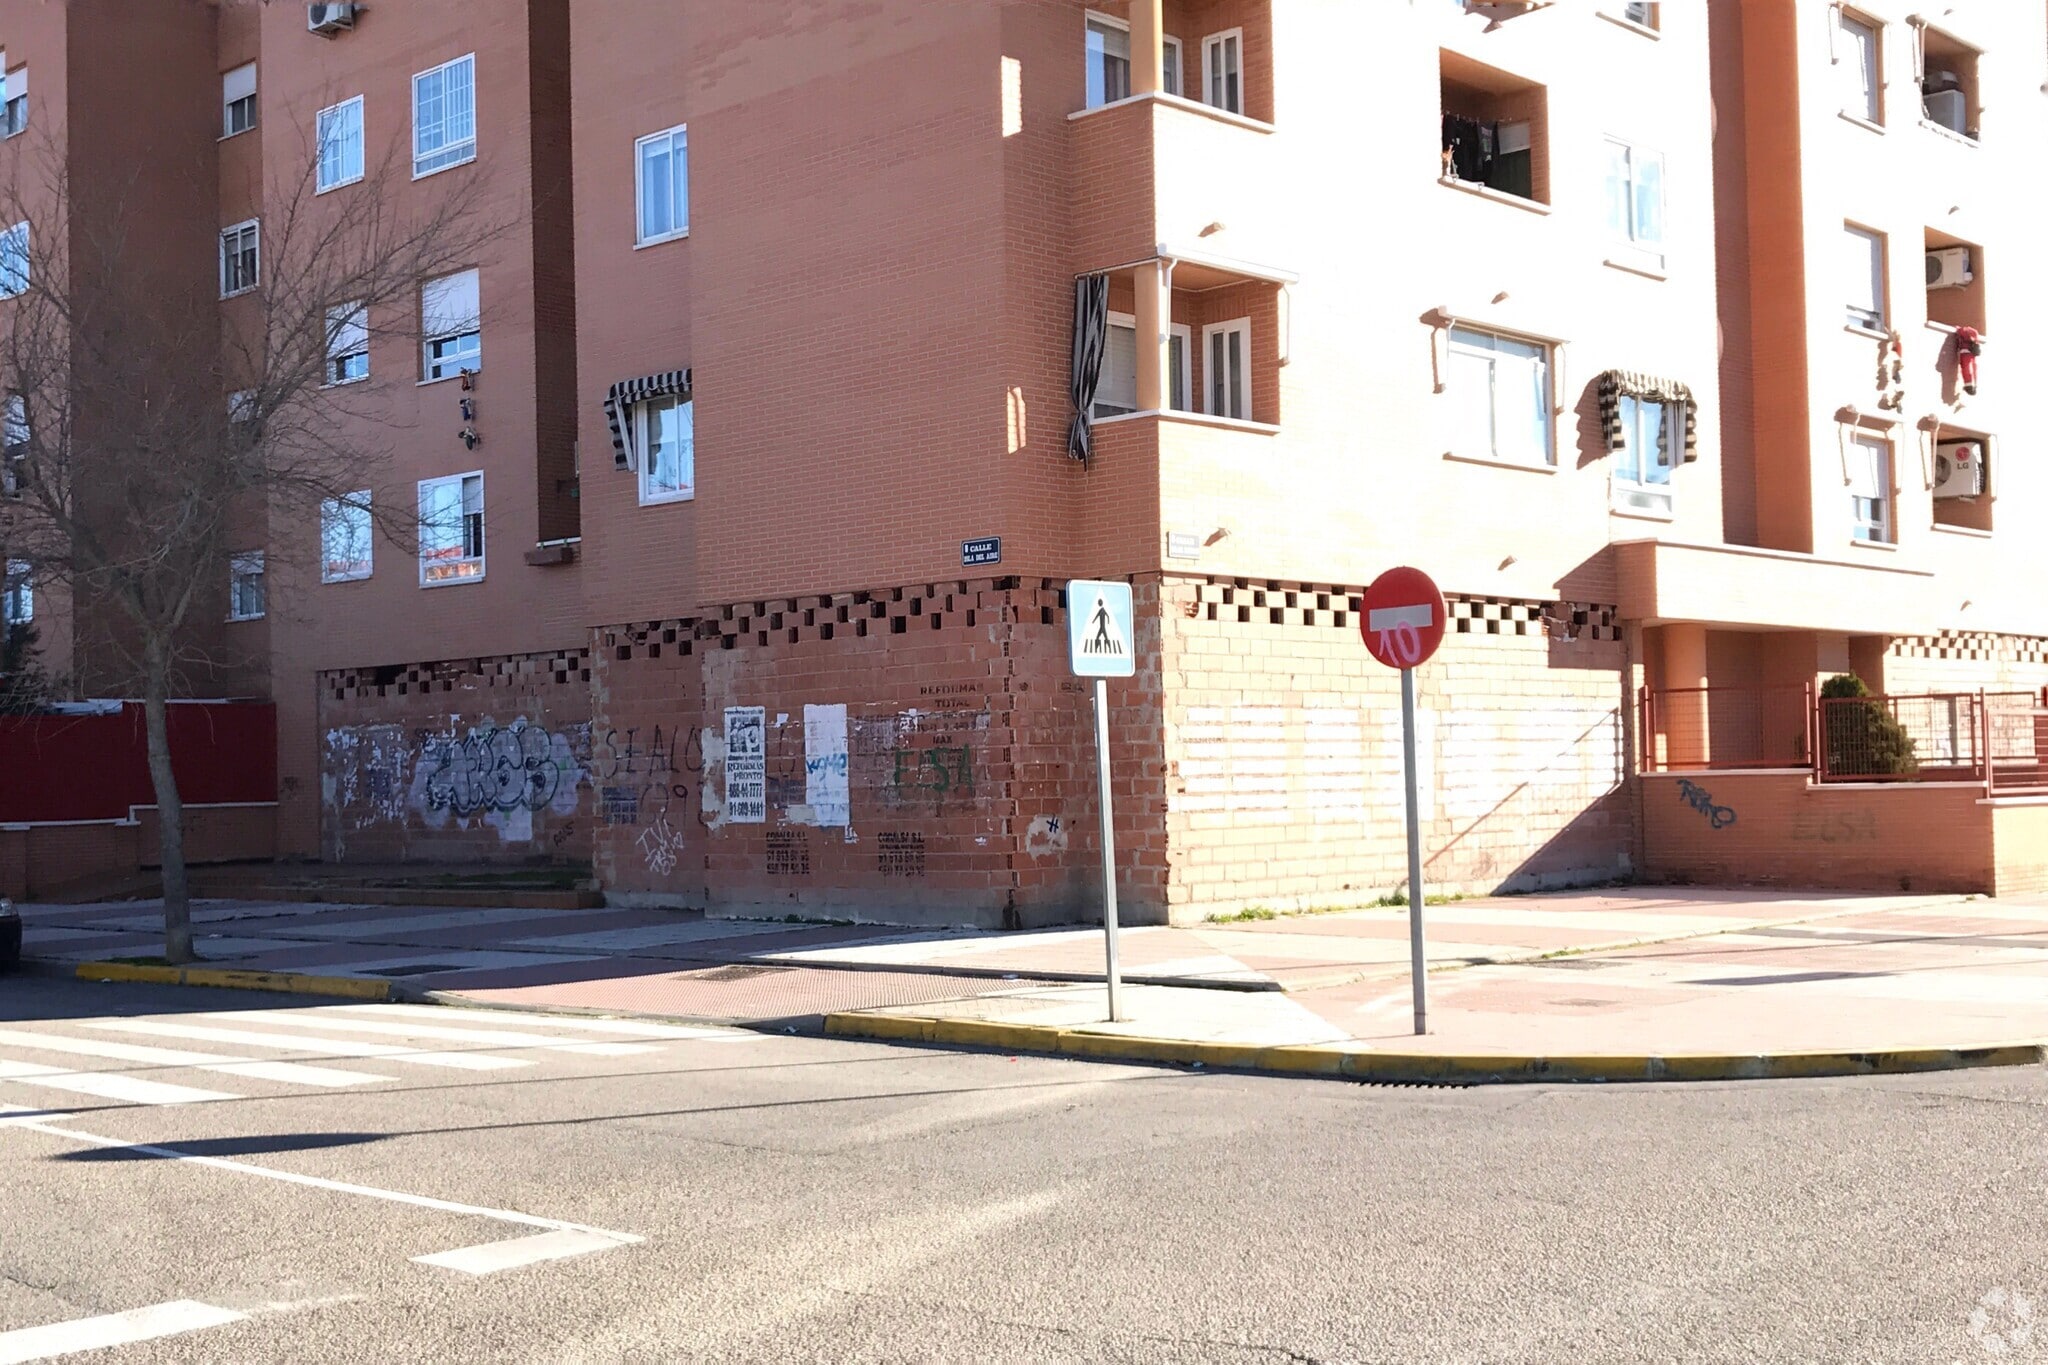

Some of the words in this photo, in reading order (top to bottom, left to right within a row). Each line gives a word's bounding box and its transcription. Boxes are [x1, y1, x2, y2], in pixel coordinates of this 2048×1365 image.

[1957, 462, 1969, 470] LG
[970, 543, 992, 553] CALLE
[976, 553, 985, 561] DEL
[728, 762, 764, 773] REFORMAS
[734, 771, 762, 782] PRONTO
